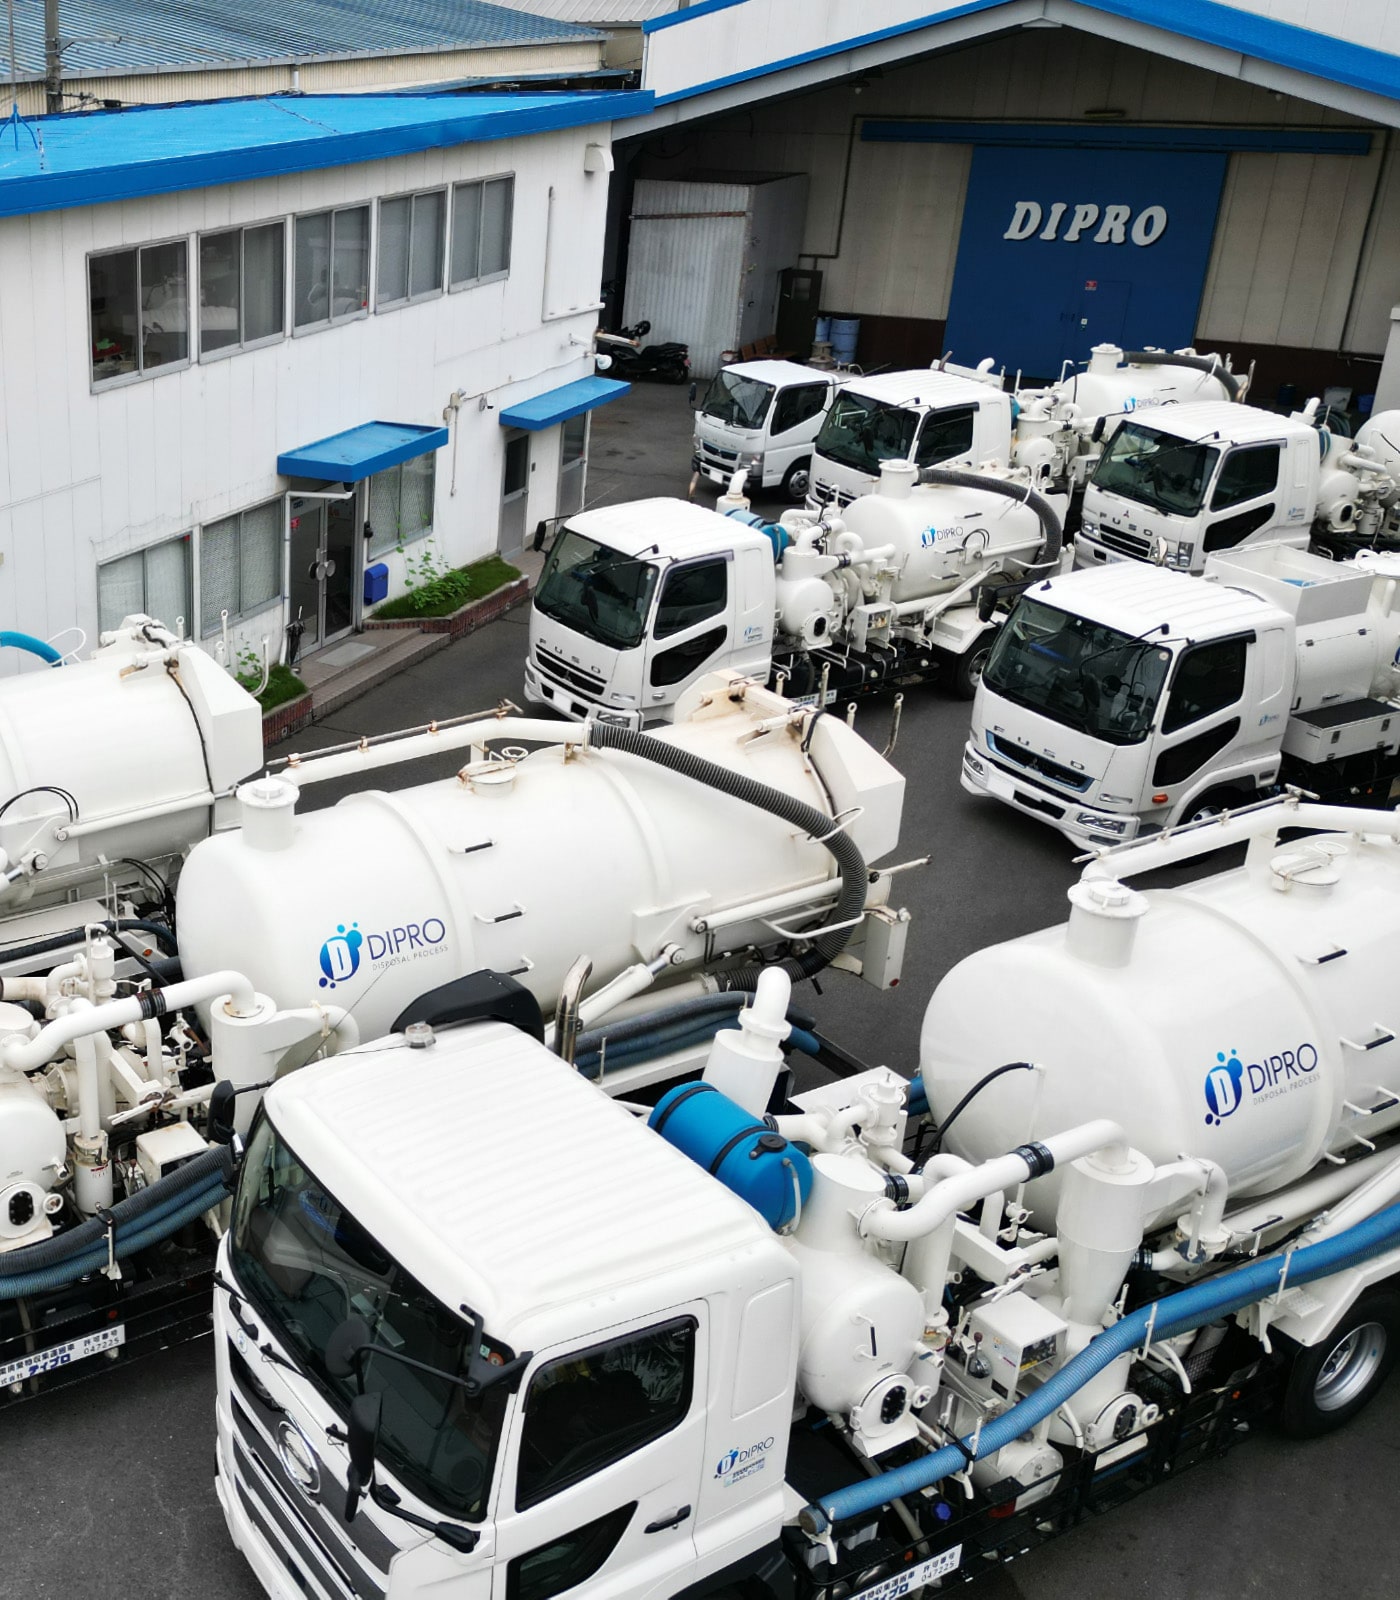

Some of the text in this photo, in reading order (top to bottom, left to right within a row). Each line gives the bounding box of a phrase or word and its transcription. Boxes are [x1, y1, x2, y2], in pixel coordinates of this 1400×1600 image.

[1003, 201, 1168, 247] DIPRO
[936, 526, 964, 541] DIPRO
[1099, 512, 1153, 537] FUSO
[539, 637, 601, 674] FUSO
[993, 725, 1085, 770] FUSO
[367, 918, 446, 960] DIPRO
[372, 944, 449, 971] DISPOSAL PROCESS
[1246, 1043, 1318, 1094] DIPRO
[1253, 1072, 1321, 1106] DISPOSAL PROCESS
[83, 1337, 119, 1356] 047225
[738, 1436, 775, 1463] DIPRO
